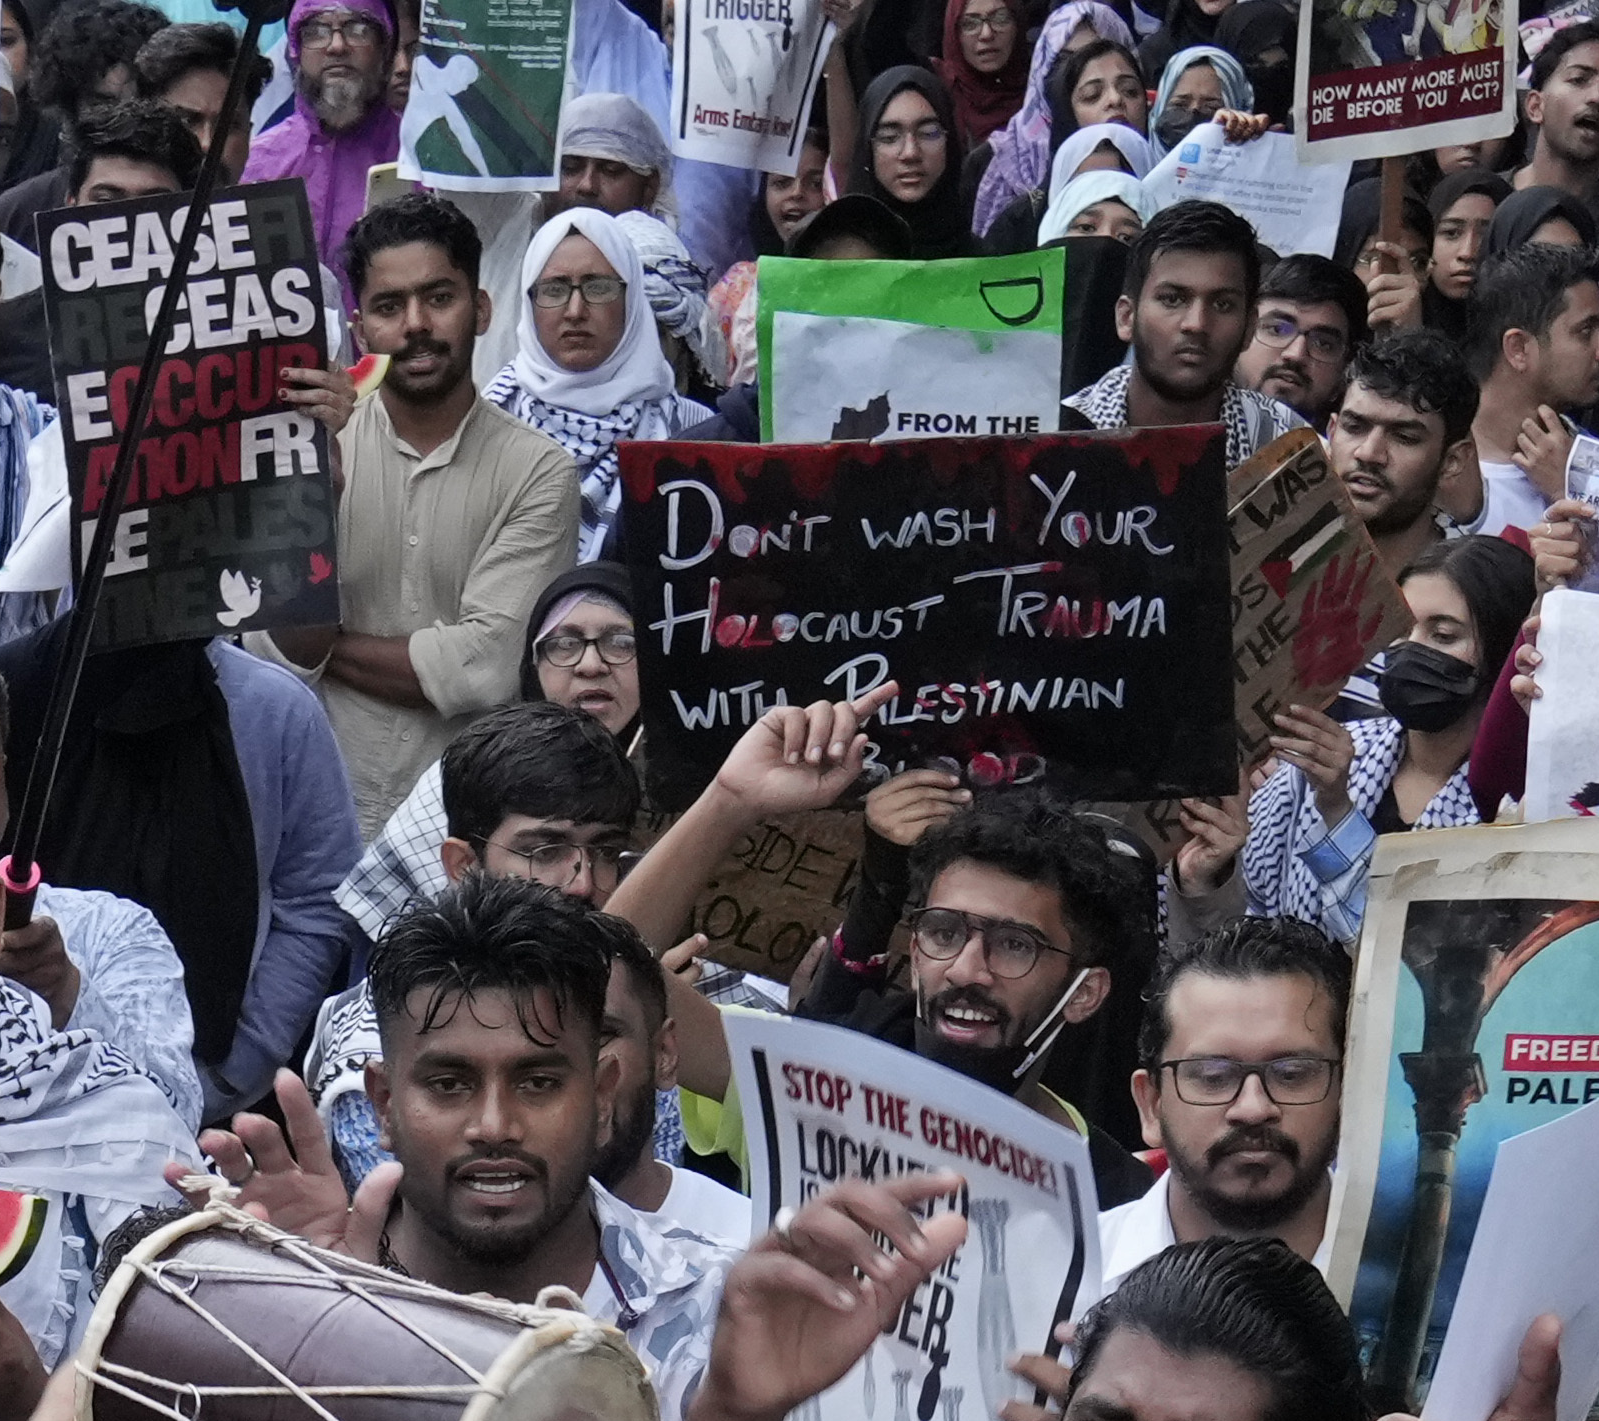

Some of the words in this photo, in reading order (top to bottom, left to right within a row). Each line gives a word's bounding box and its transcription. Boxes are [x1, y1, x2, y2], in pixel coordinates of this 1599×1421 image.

[1311, 83, 1353, 106] HOW
[1355, 77, 1407, 99] MANY
[1410, 69, 1456, 93] MORE
[1459, 61, 1501, 84] MUST
[1311, 106, 1334, 126] DIE
[1346, 98, 1404, 120] BEFORE
[1414, 90, 1448, 111] YOU
[1459, 81, 1501, 103] ACT?
[693, 104, 729, 127] Arms
[896, 411, 979, 435] FROM
[984, 413, 1041, 435] THE
[657, 479, 833, 571] DON'T
[861, 506, 998, 550] WASH
[1029, 470, 1175, 556] YOUR
[1242, 458, 1329, 532] WAS
[648, 577, 946, 655] HOLOCAUST
[953, 561, 1167, 639] TRAUMA
[780, 1060, 853, 1115] STOP
[859, 1082, 914, 1139] THE
[919, 1105, 1061, 1200] GENOCIDE!
